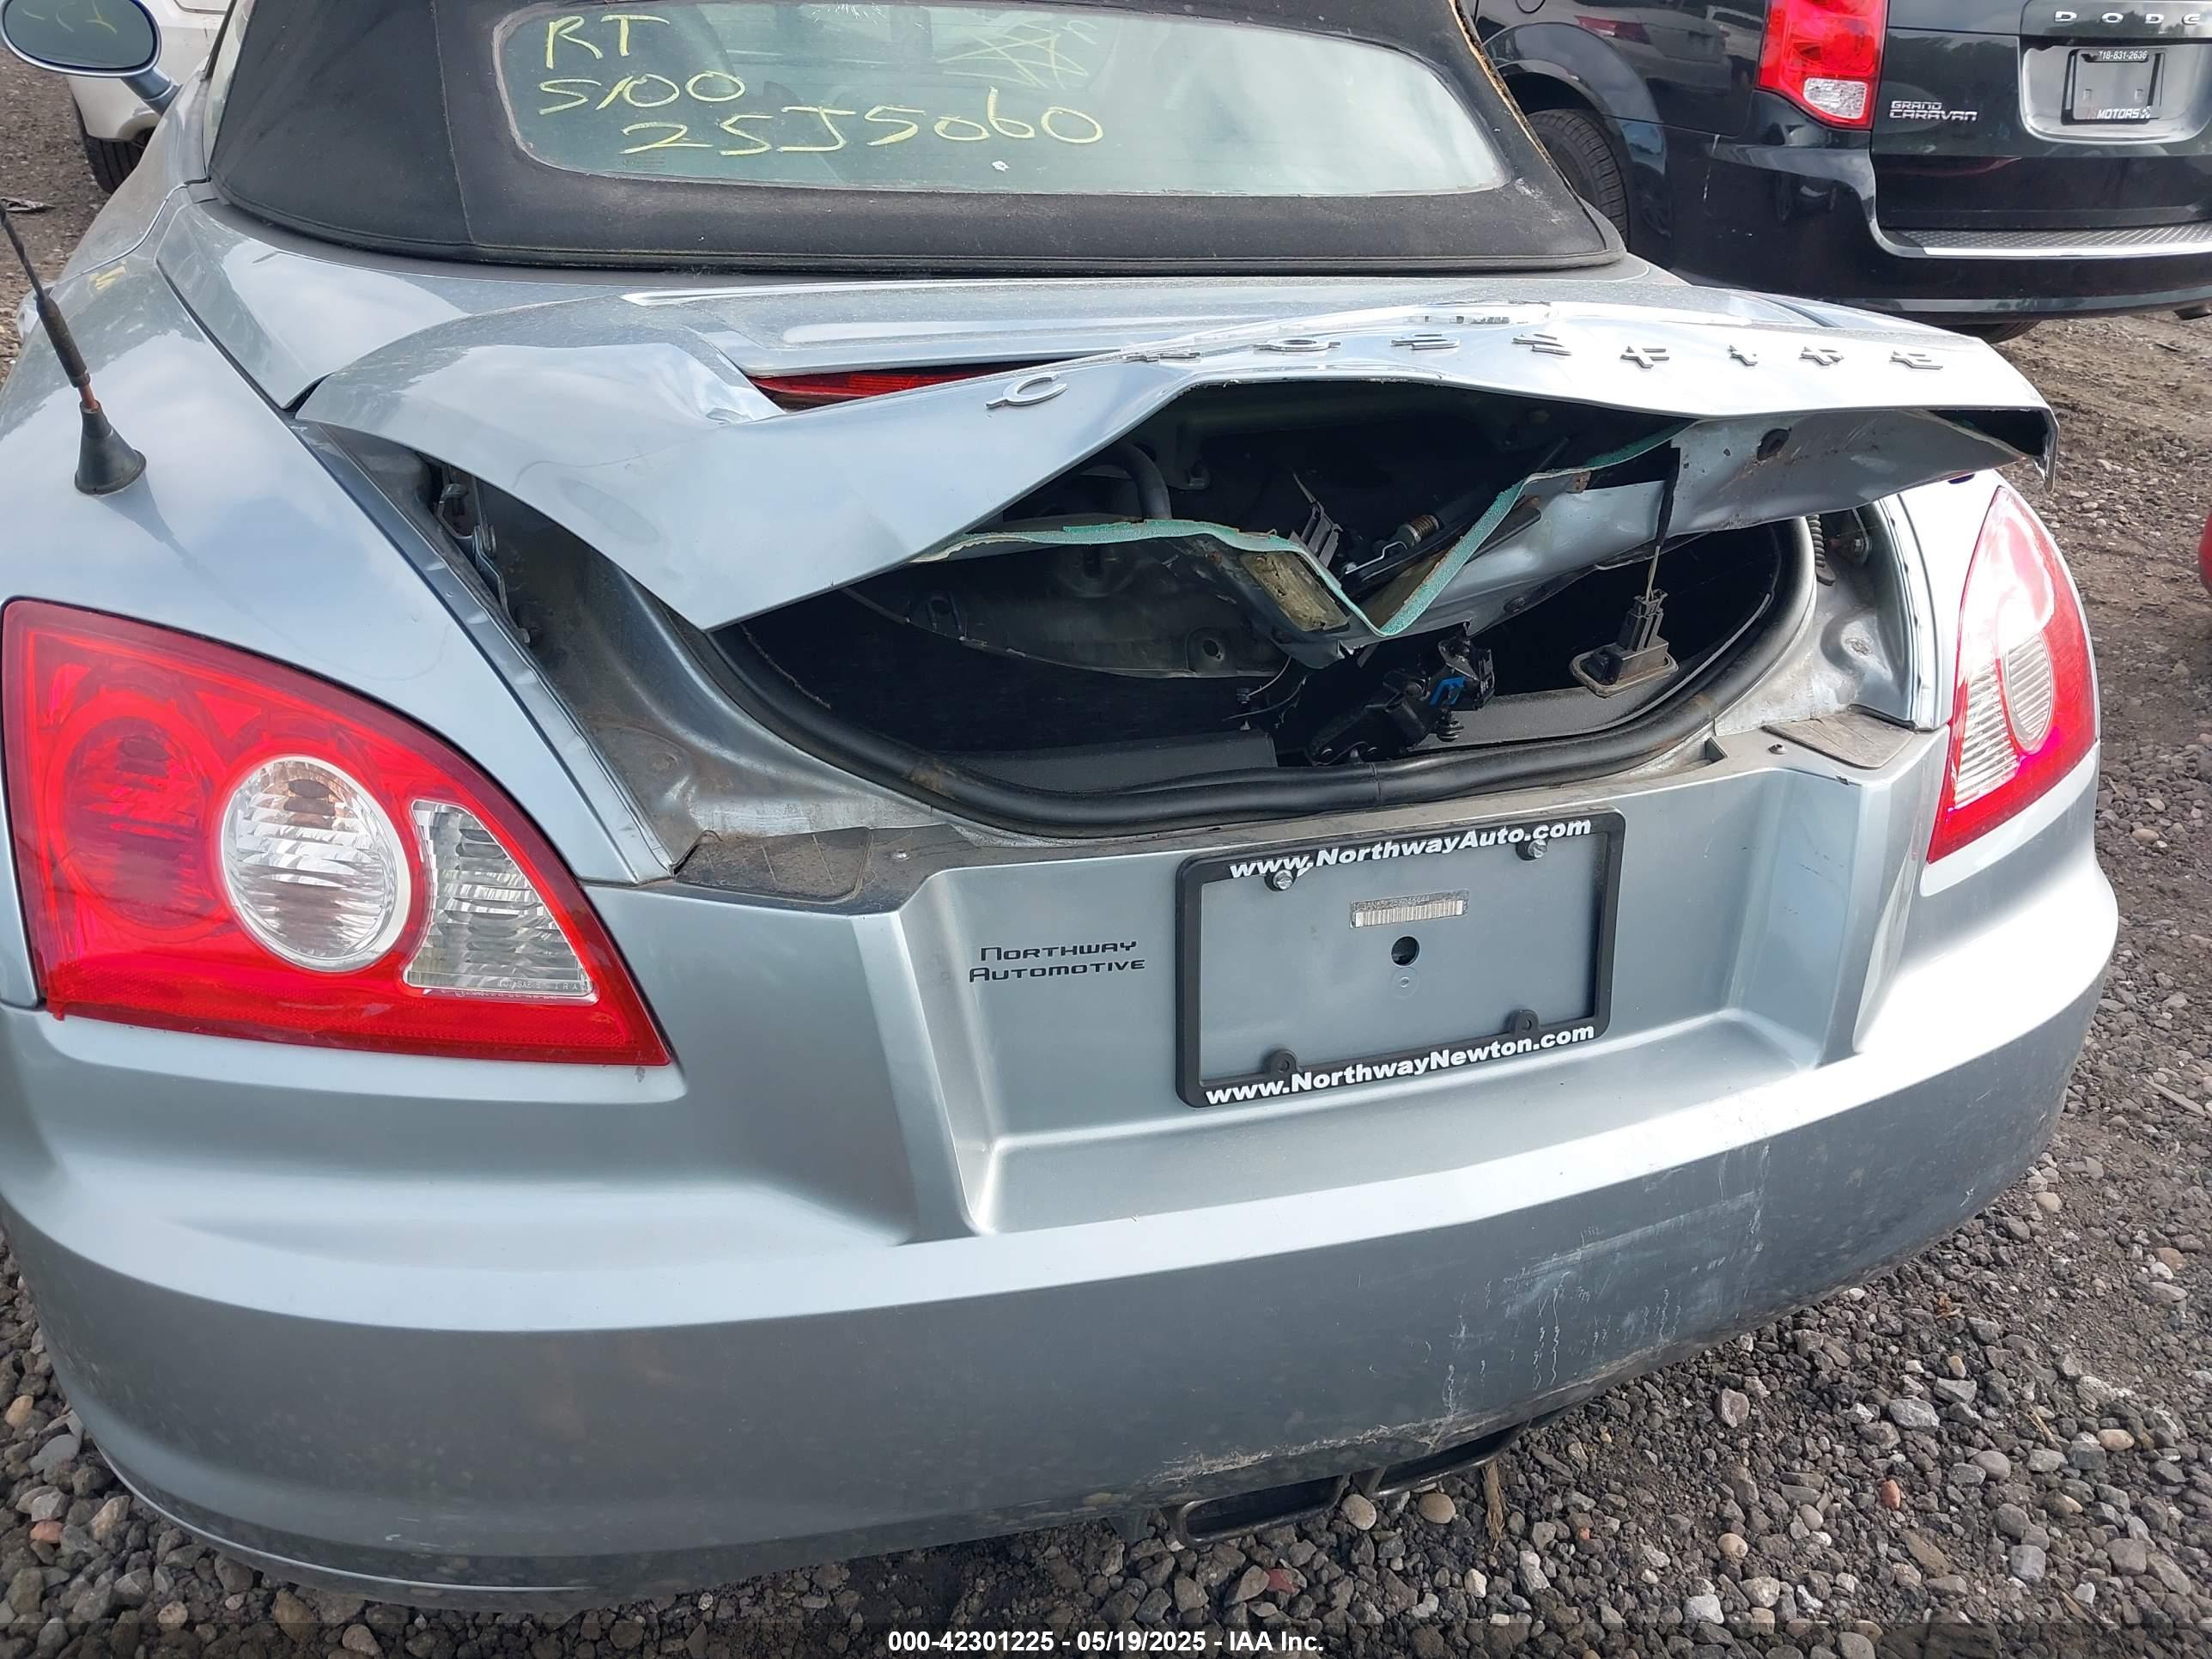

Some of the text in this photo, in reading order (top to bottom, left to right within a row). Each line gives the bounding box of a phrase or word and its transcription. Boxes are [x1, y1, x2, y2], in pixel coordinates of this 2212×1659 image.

[544, 14, 670, 69] RT
[1889, 109, 1978, 122] CARAVAN
[1890, 100, 1943, 110] GRAND
[2096, 107, 2141, 119] MOTORS
[1230, 817, 1592, 880] www.NorthwayAuto.com
[1206, 1025, 1595, 1106] www.NorthwayNewton.com
